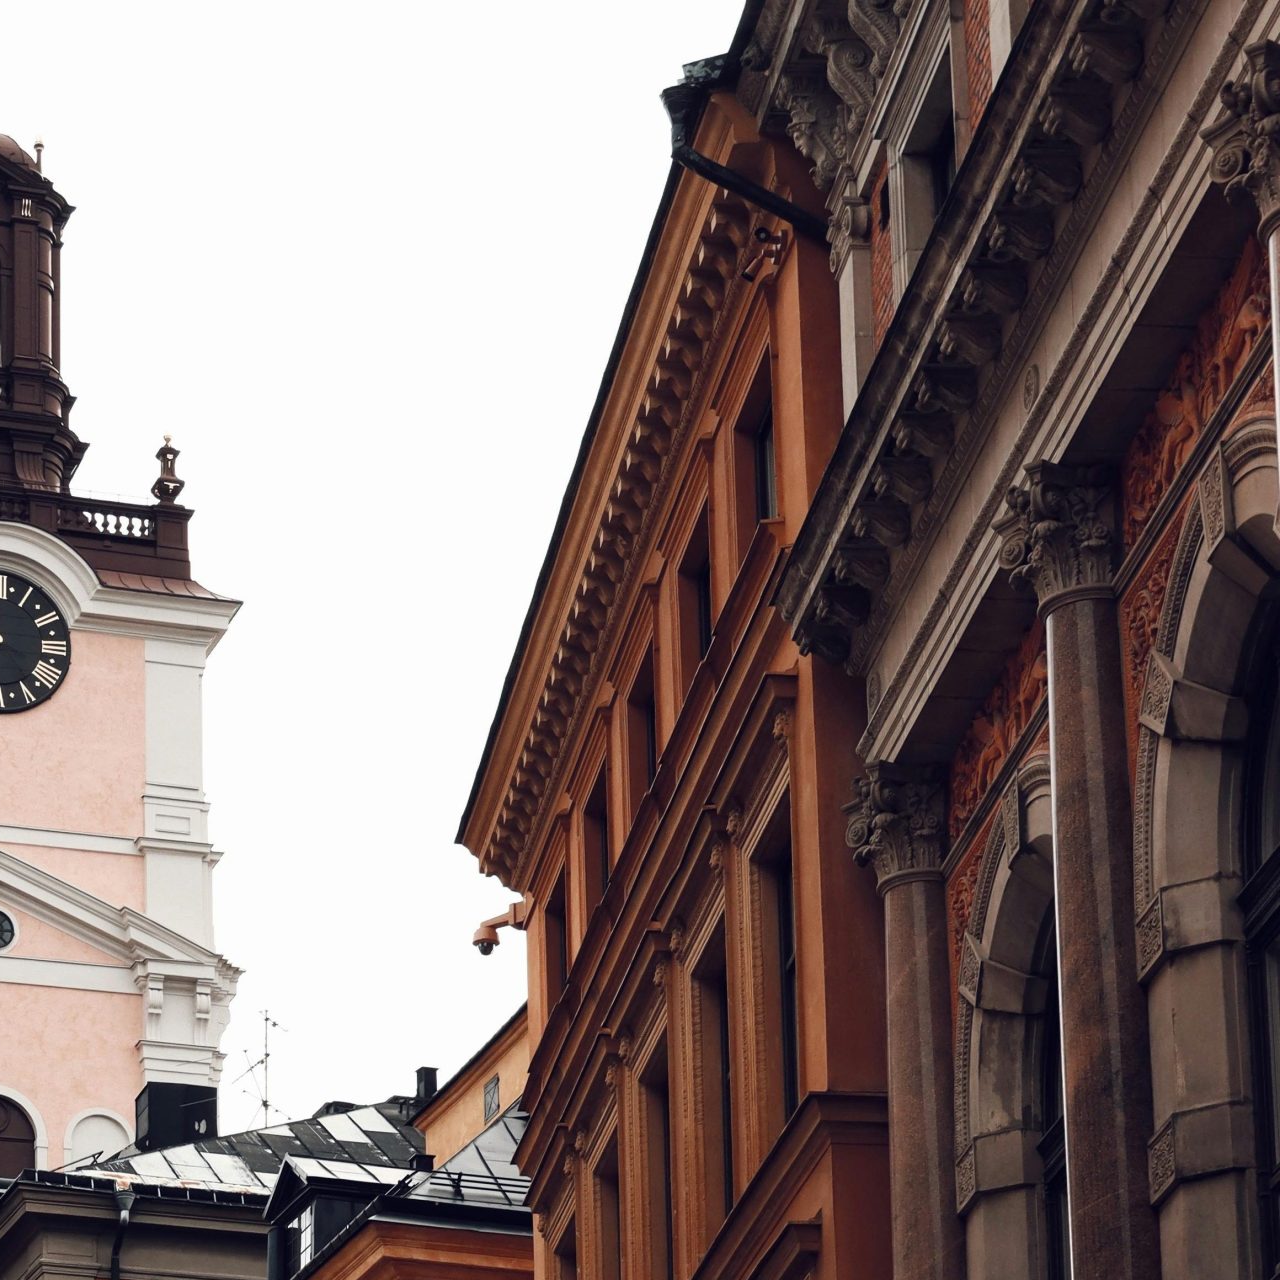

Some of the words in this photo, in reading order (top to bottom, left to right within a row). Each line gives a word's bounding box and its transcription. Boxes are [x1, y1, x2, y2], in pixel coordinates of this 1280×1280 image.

[18, 586, 34, 608] I
[34, 611, 60, 628] II
[41, 640, 67, 657] III
[32, 660, 62, 690] IIII
[19, 680, 36, 704] V
